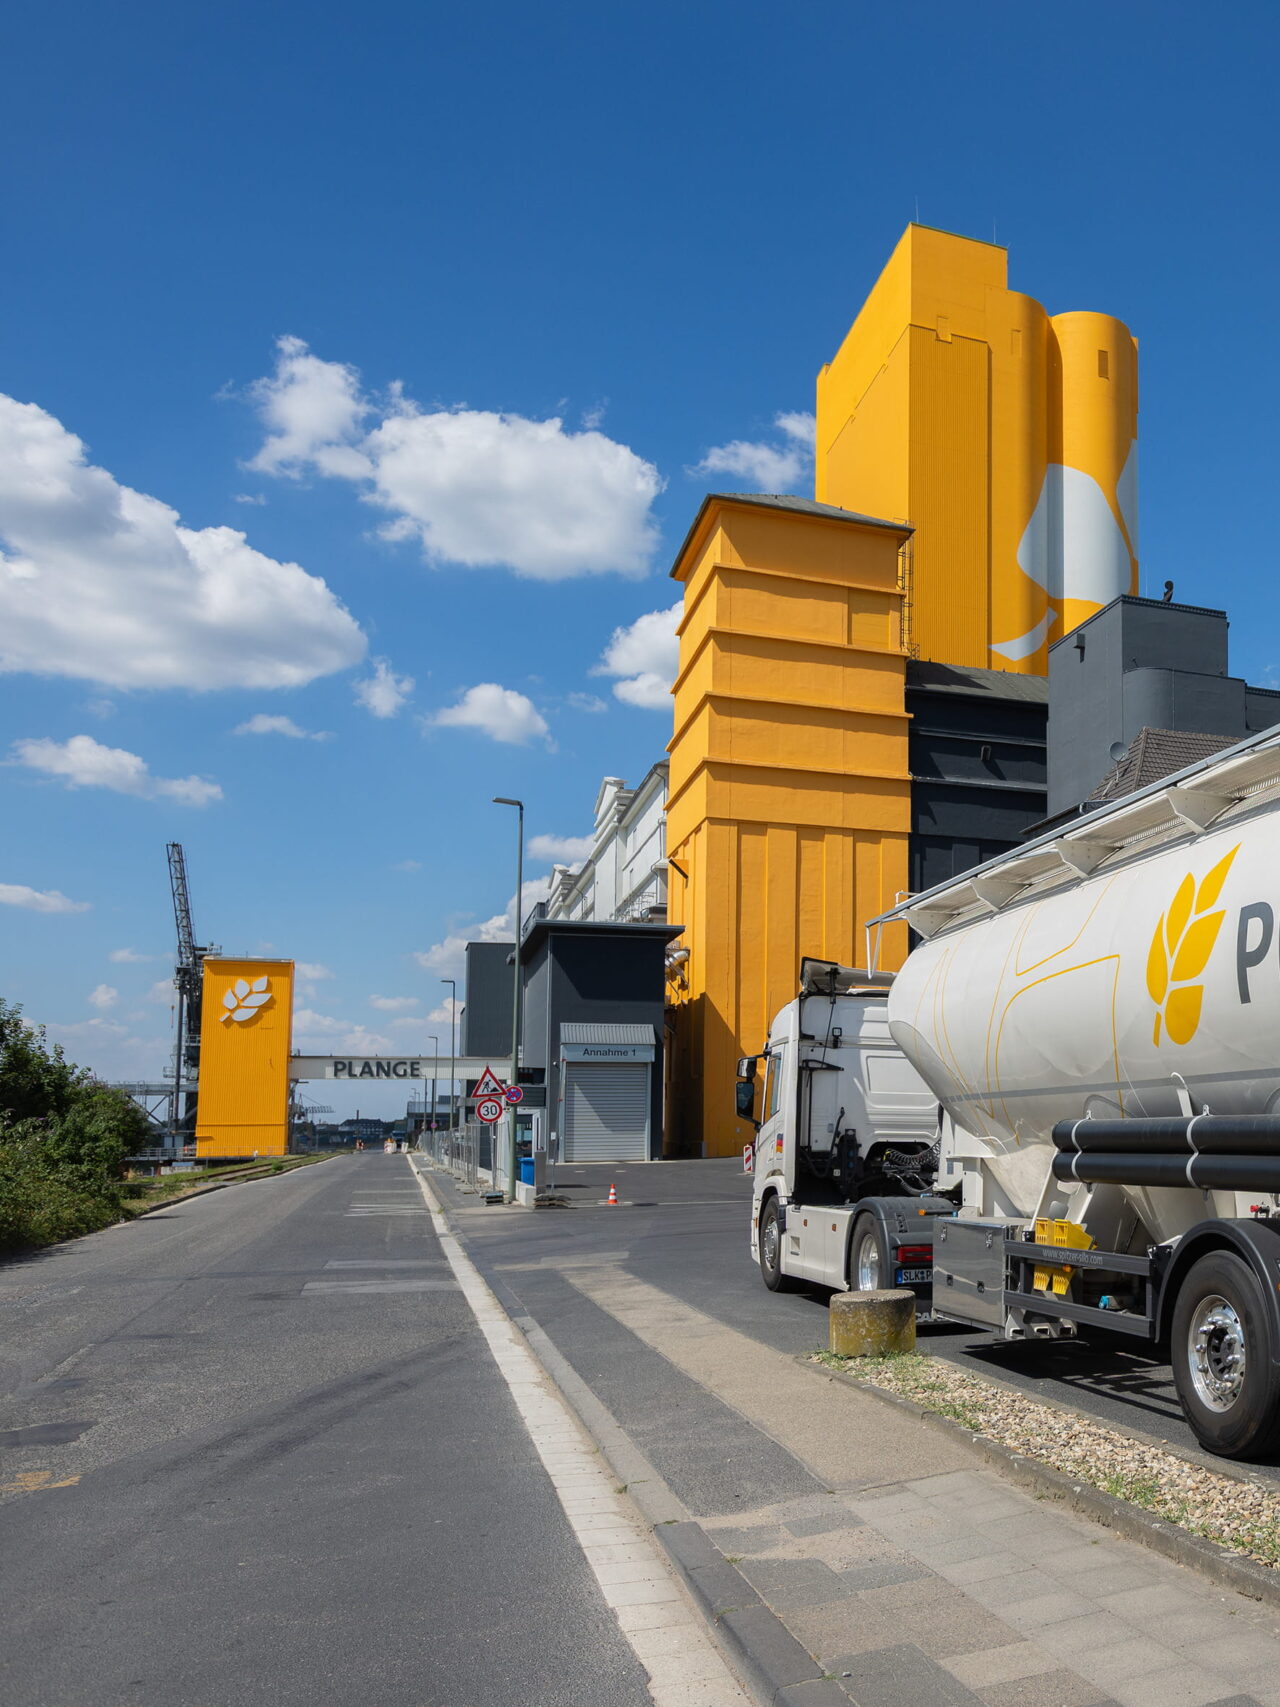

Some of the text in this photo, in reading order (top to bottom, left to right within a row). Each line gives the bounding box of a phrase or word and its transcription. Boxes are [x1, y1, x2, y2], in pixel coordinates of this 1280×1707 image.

[582, 1048, 637, 1057] Annahme 1
[333, 1060, 421, 1078] PLANGE
[481, 1104, 498, 1117] 30
[903, 1270, 921, 1282] SLK
